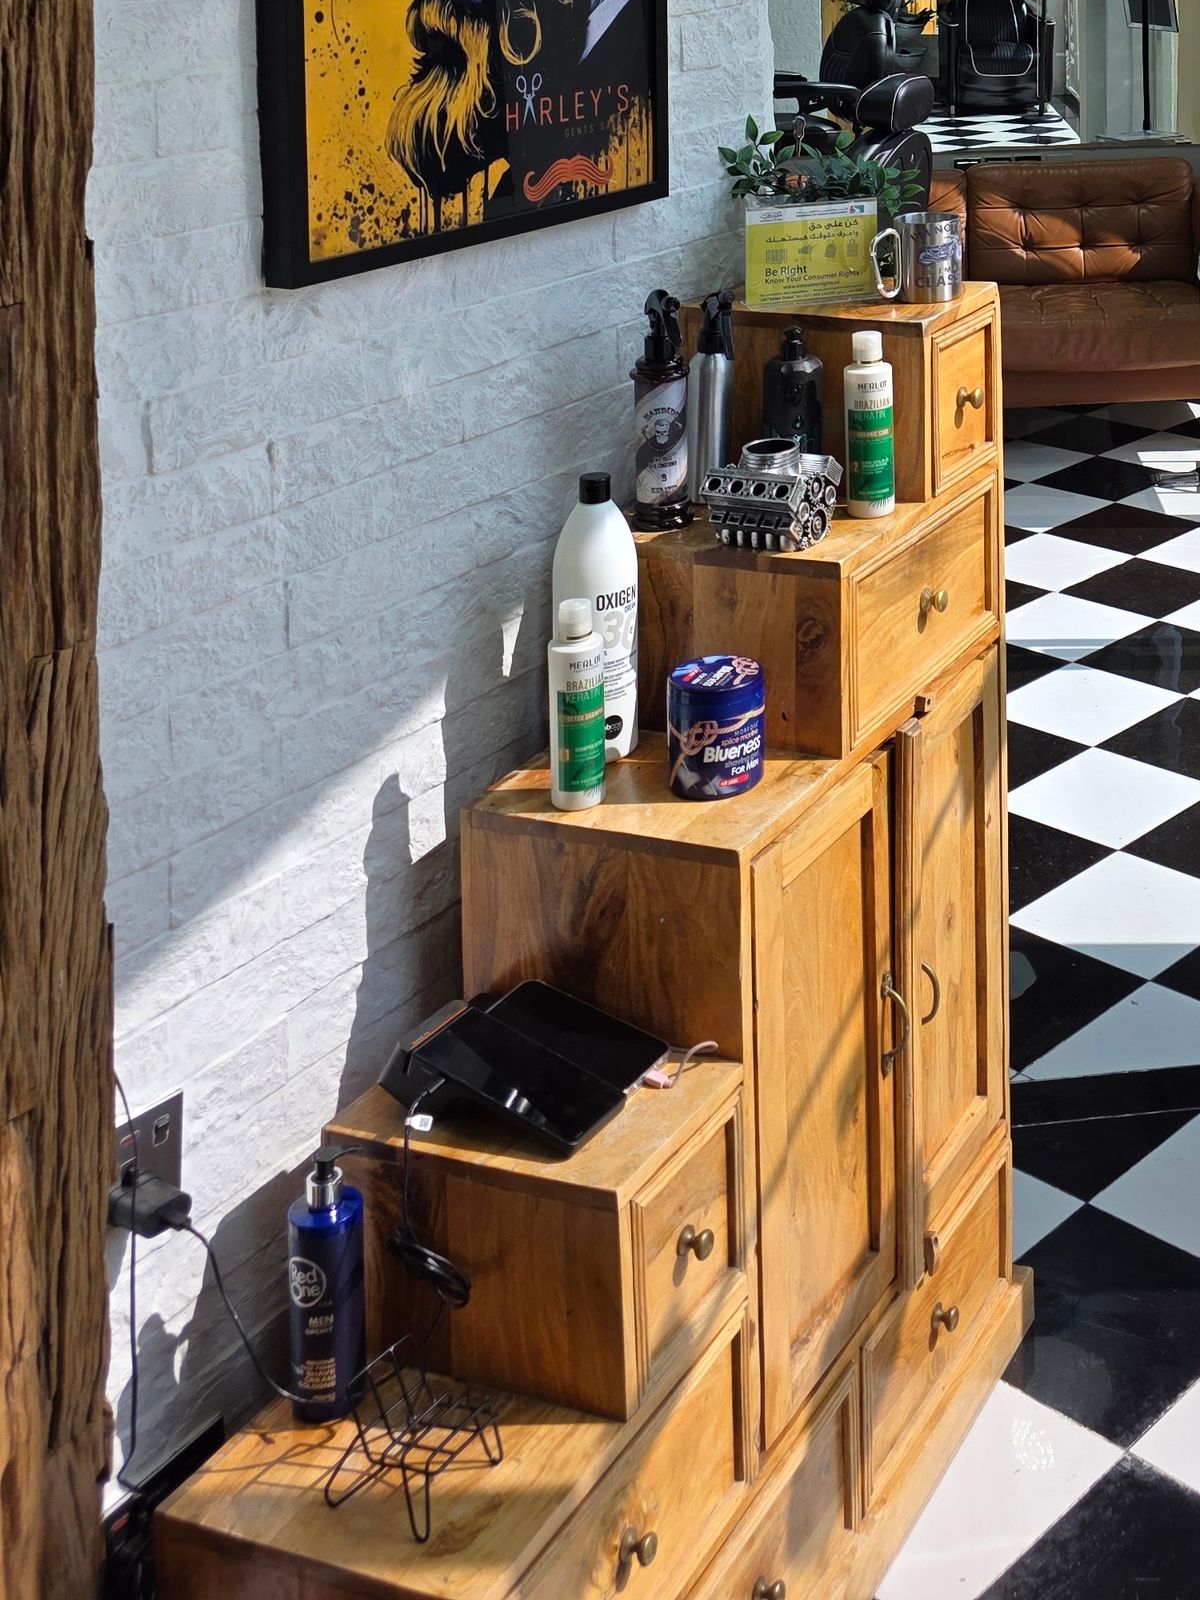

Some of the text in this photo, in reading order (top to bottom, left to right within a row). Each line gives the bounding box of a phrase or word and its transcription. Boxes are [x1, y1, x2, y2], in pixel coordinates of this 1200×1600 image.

[505, 74, 630, 133] HARLEY'S
[564, 124, 595, 139] GENTS
[764, 269, 860, 285] Know Your Consumer Rights
[765, 265, 807, 278] Be Right
[857, 379, 888, 392] MERLOT
[854, 409, 886, 421] KERATIN
[595, 584, 637, 612] OXIGEN
[569, 653, 602, 671] MERLOT
[565, 687, 601, 704] KERATIN
[720, 736, 740, 746] spice
[703, 735, 762, 764] Blueness
[724, 755, 750, 769] shaving
[731, 758, 760, 776] FOR MEN
[290, 1263, 318, 1285] Red
[291, 1281, 321, 1300] One
[308, 1313, 335, 1329] MEN
